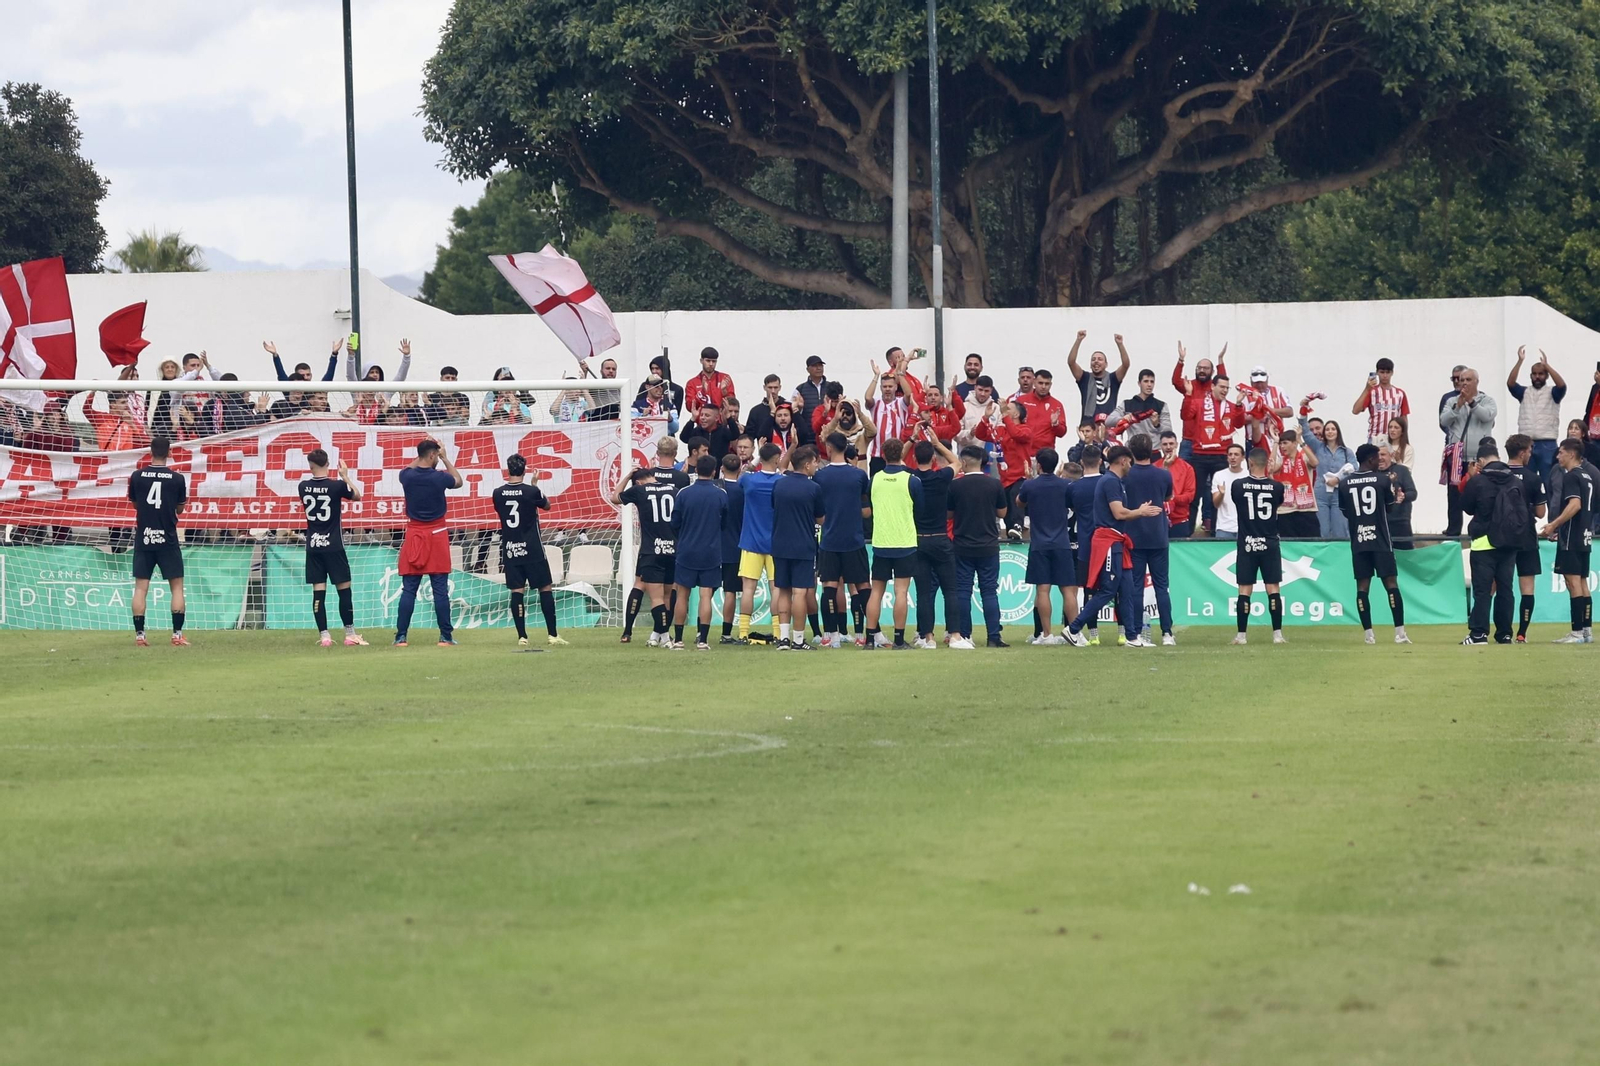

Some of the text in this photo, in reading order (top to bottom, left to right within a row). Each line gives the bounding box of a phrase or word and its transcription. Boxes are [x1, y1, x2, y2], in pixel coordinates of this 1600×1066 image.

[146, 481, 162, 510] 4
[232, 501, 277, 514] ACF
[303, 494, 331, 522] 23
[647, 494, 675, 523] 10
[1243, 492, 1273, 520] 15
[1349, 486, 1377, 517] 19
[505, 500, 520, 528] 3
[39, 570, 91, 580] CARNES
[1187, 598, 1214, 617] La
